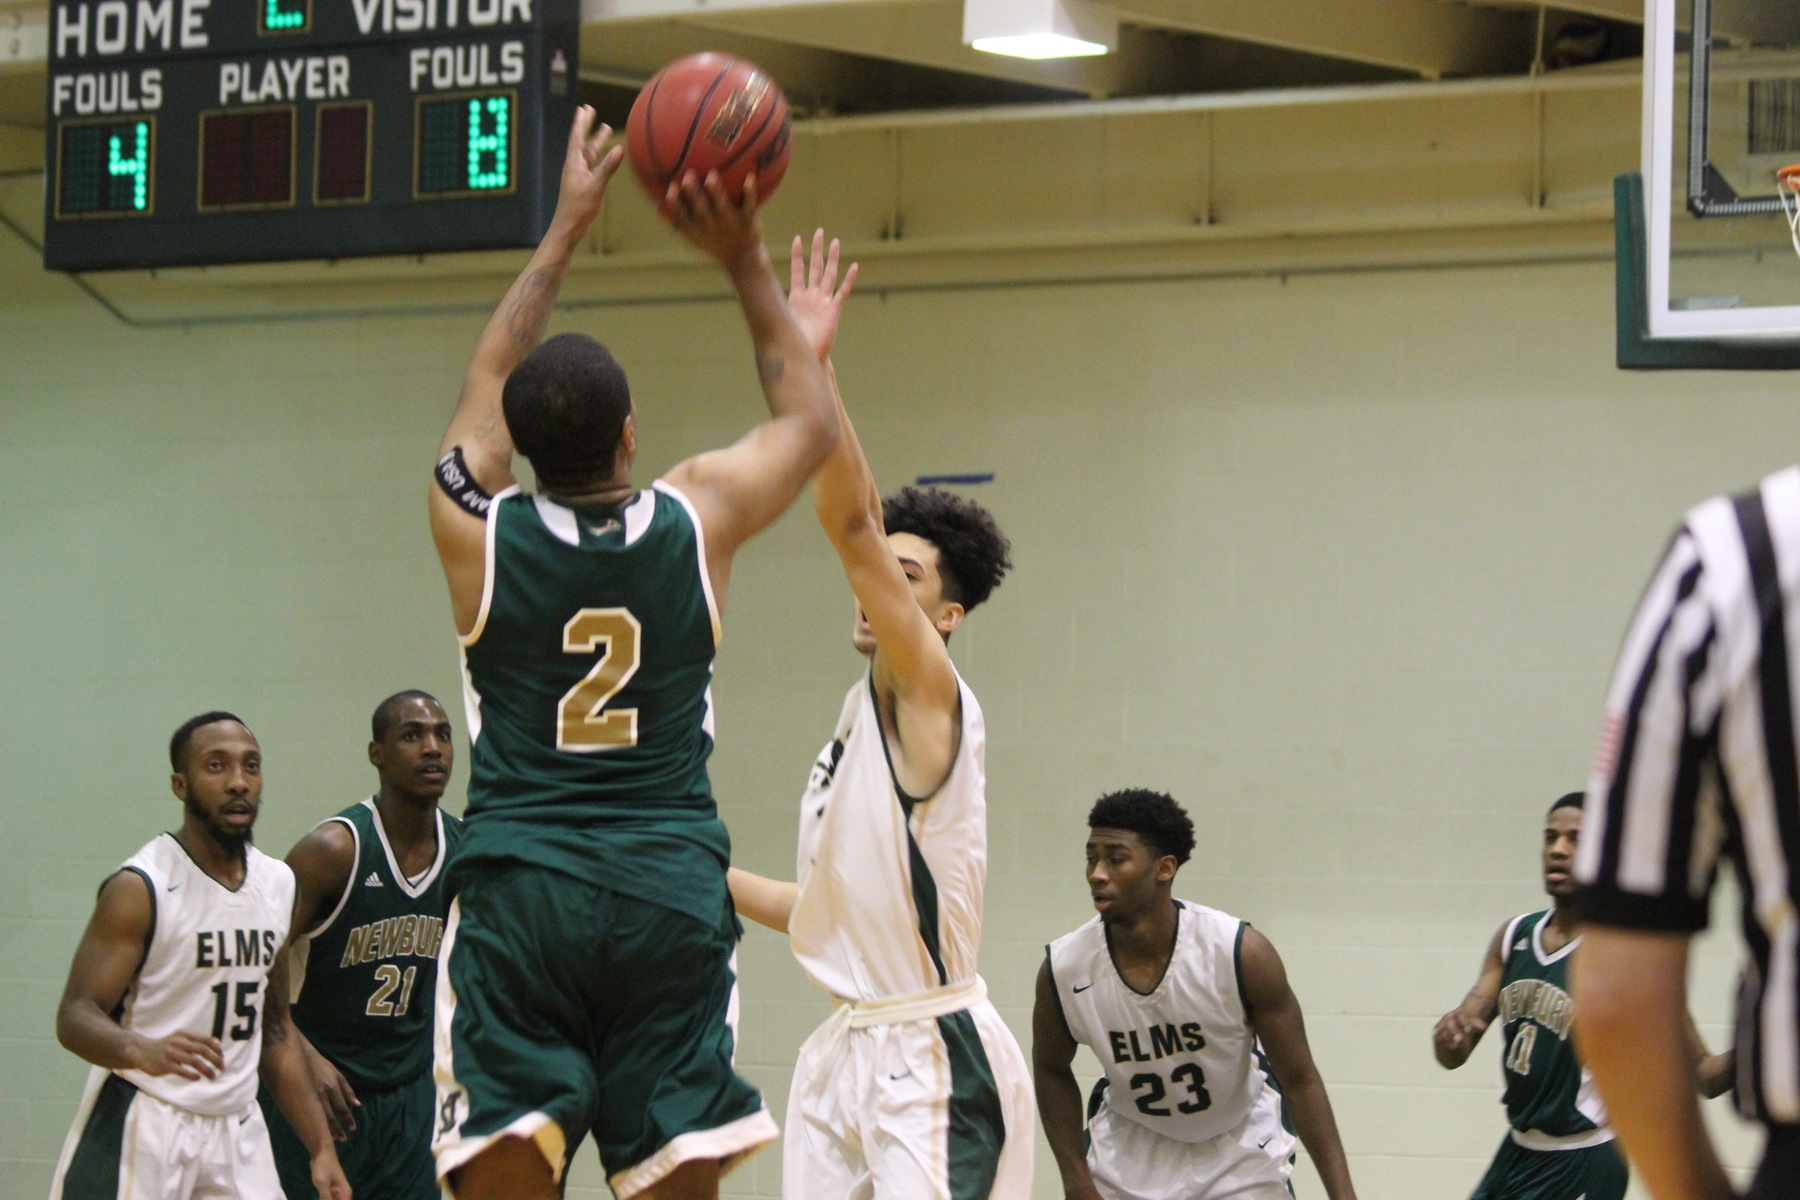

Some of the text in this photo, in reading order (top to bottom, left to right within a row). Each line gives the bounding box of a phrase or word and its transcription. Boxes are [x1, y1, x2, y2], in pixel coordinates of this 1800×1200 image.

[57, 0, 210, 58] HOME
[53, 69, 162, 116] FOULS
[220, 55, 350, 105] PLAYER
[411, 41, 524, 91] FOULS
[109, 122, 148, 210] 4
[468, 97, 508, 188] 8
[556, 607, 641, 752] 2
[196, 929, 275, 968] ELMS
[211, 982, 259, 1041] 15
[365, 964, 417, 1017] 21
[1109, 1022, 1206, 1064] ELMS
[1130, 1063, 1212, 1117] 23
